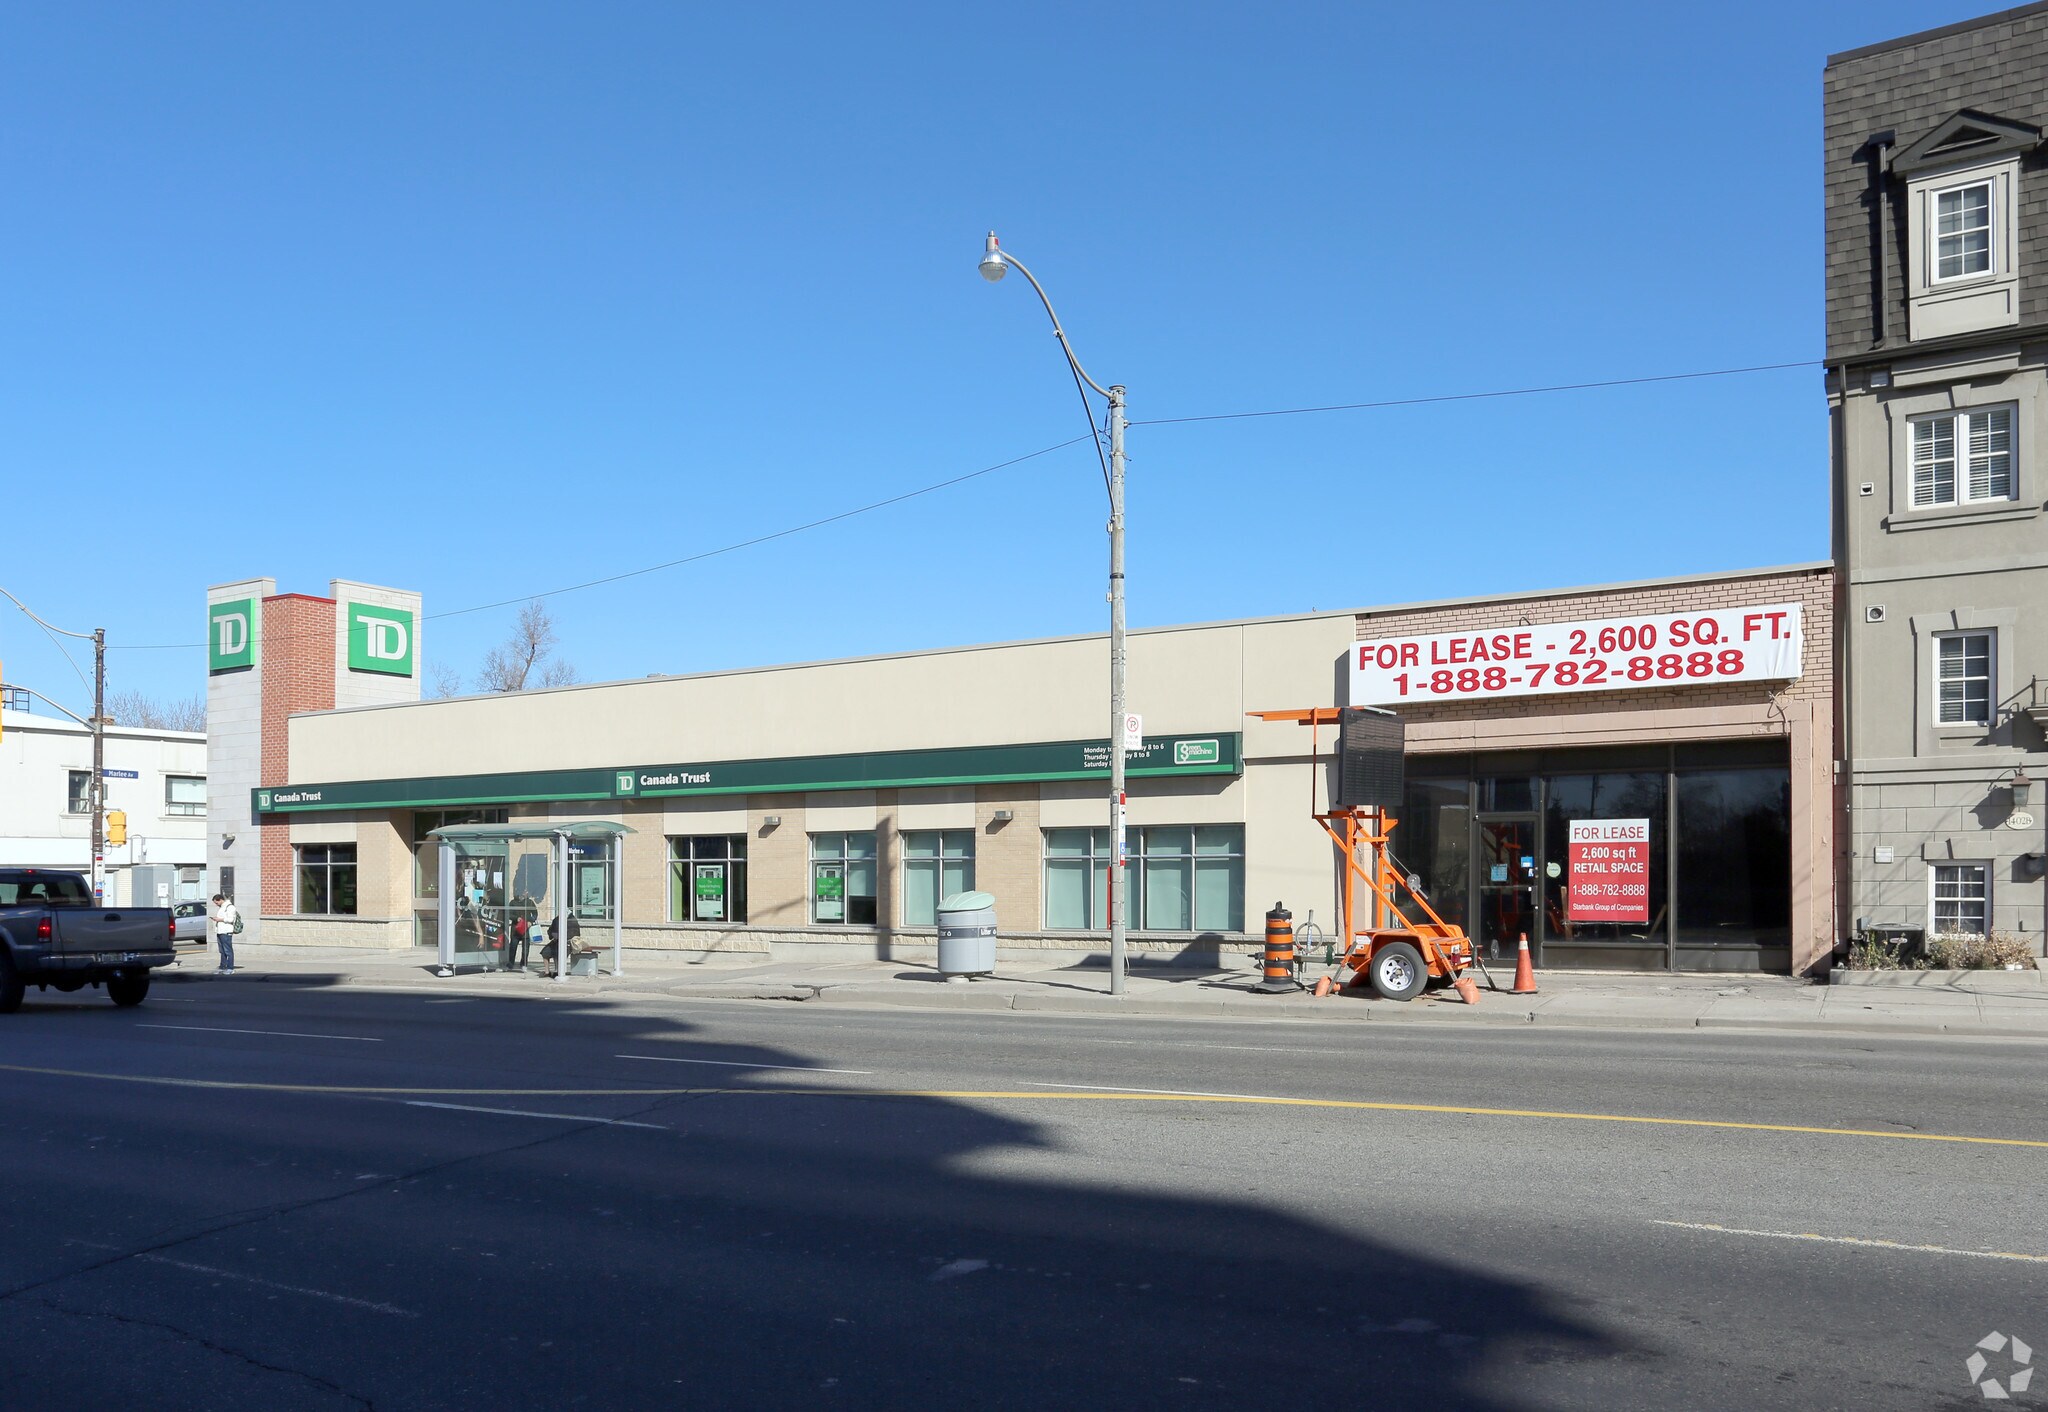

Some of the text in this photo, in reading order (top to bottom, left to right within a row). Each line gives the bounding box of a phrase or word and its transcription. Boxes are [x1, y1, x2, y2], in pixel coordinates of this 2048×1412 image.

[213, 613, 247, 655] TD
[356, 615, 407, 660] TD
[1359, 644, 1419, 670] FOR
[1431, 633, 1532, 665] LEASE
[1569, 624, 1657, 659] 2,600
[1668, 617, 1729, 647] SQ.
[1743, 611, 1791, 642] FT.
[1393, 649, 1745, 696] 1-888-782-8888
[618, 772, 710, 790] TD Canada Trust
[260, 792, 321, 806] TD Canada Trust
[1574, 826, 1644, 839] FOR LEASE
[1582, 847, 1636, 860] 2,600 sq ft
[1574, 863, 1643, 873] RETAIL SPACE
[1573, 884, 1645, 896] 1-888-782-8888
[1617, 904, 1644, 912] Companies
